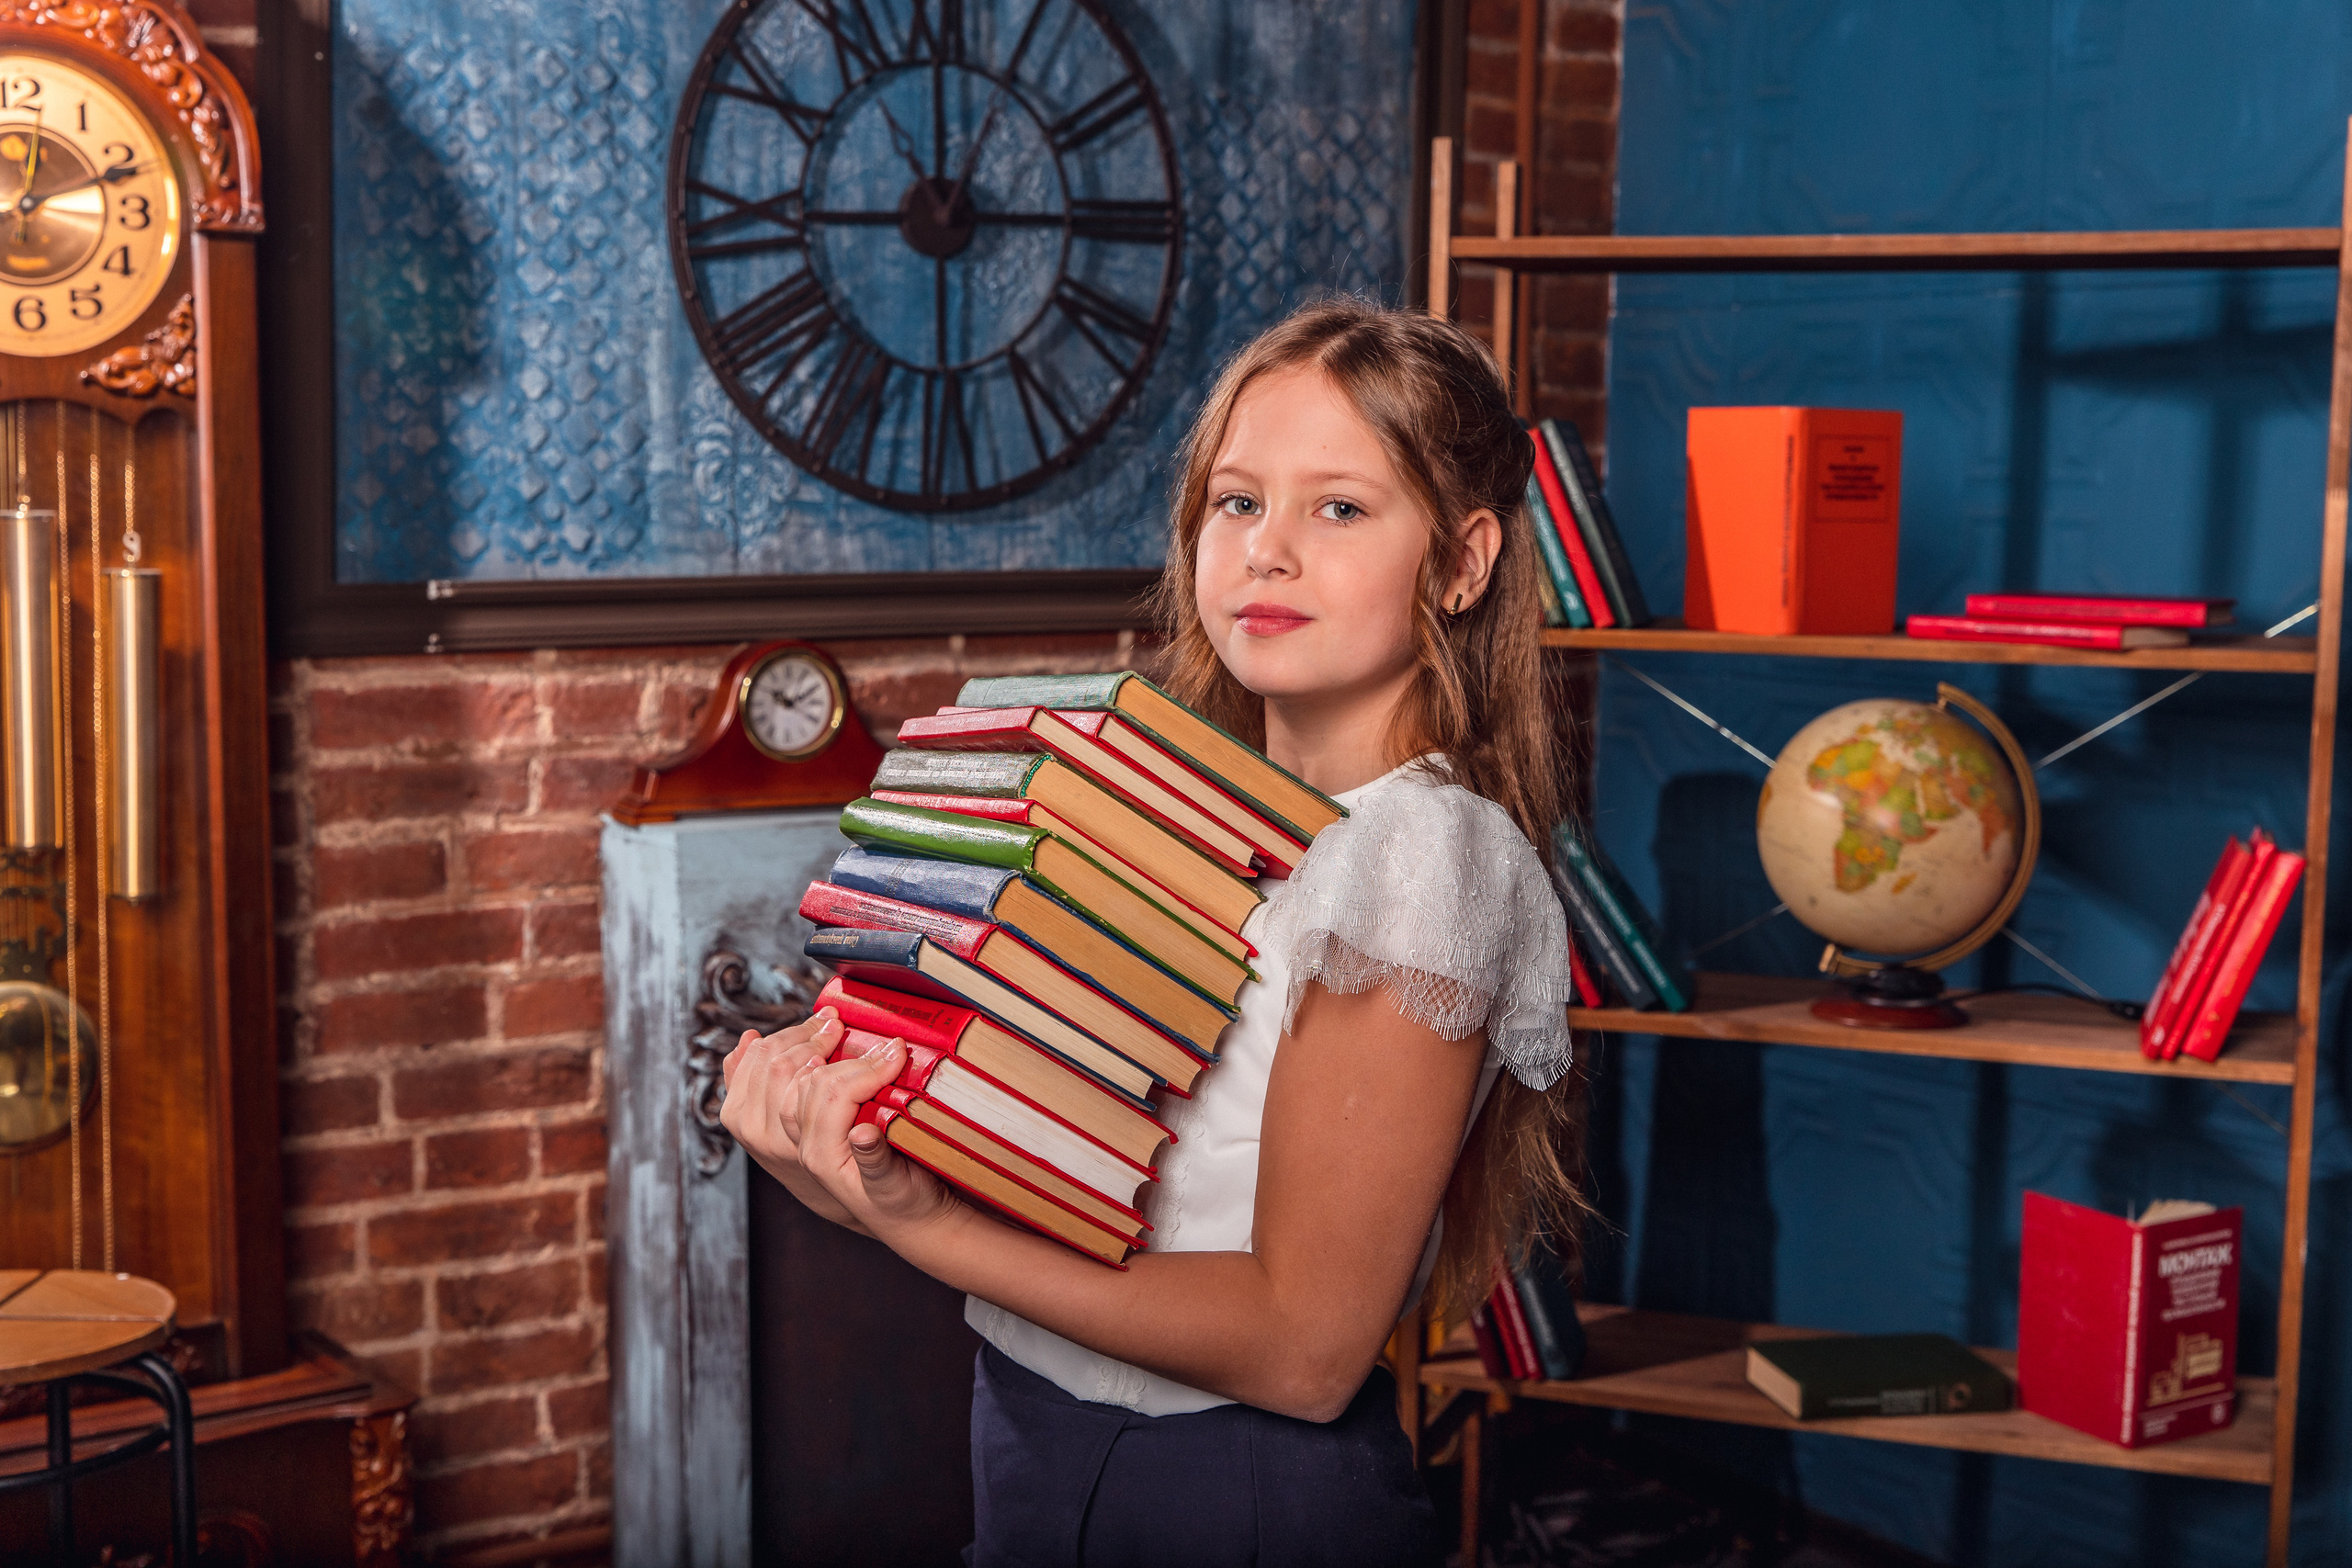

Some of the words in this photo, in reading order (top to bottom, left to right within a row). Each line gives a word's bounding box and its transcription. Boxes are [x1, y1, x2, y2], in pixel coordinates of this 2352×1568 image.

[0, 76, 41, 112] 12
[77, 101, 87, 131] 1
[104, 142, 136, 175] 2
[120, 194, 151, 231] 3
[103, 244, 135, 276] 4
[14, 294, 47, 333] 6
[70, 283, 103, 320] 5
